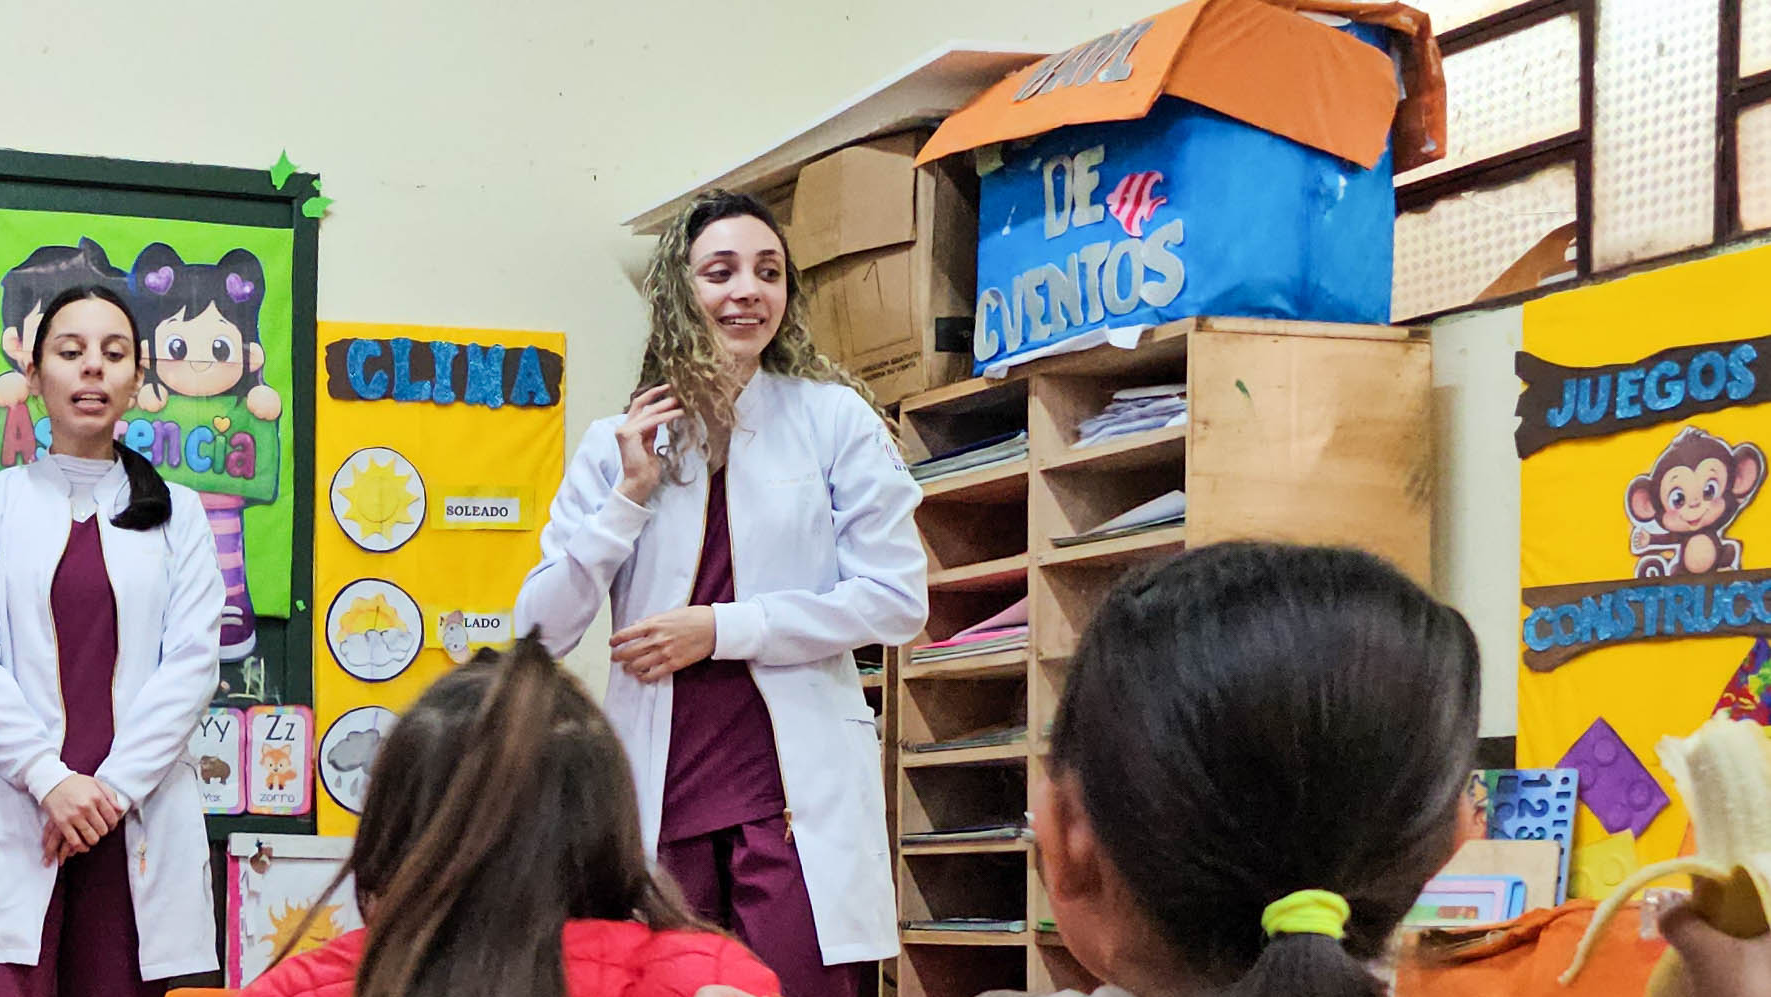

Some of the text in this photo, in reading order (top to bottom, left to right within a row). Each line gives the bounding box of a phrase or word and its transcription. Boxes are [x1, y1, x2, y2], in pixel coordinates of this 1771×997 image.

[1043, 144, 1105, 240] DE
[346, 337, 552, 409] CLIMA
[1546, 343, 1758, 429] JUEGOS
[0, 400, 257, 480] Asencia
[445, 504, 509, 518] SOLEADO
[199, 716, 231, 743] Yy
[265, 714, 296, 741] Zz
